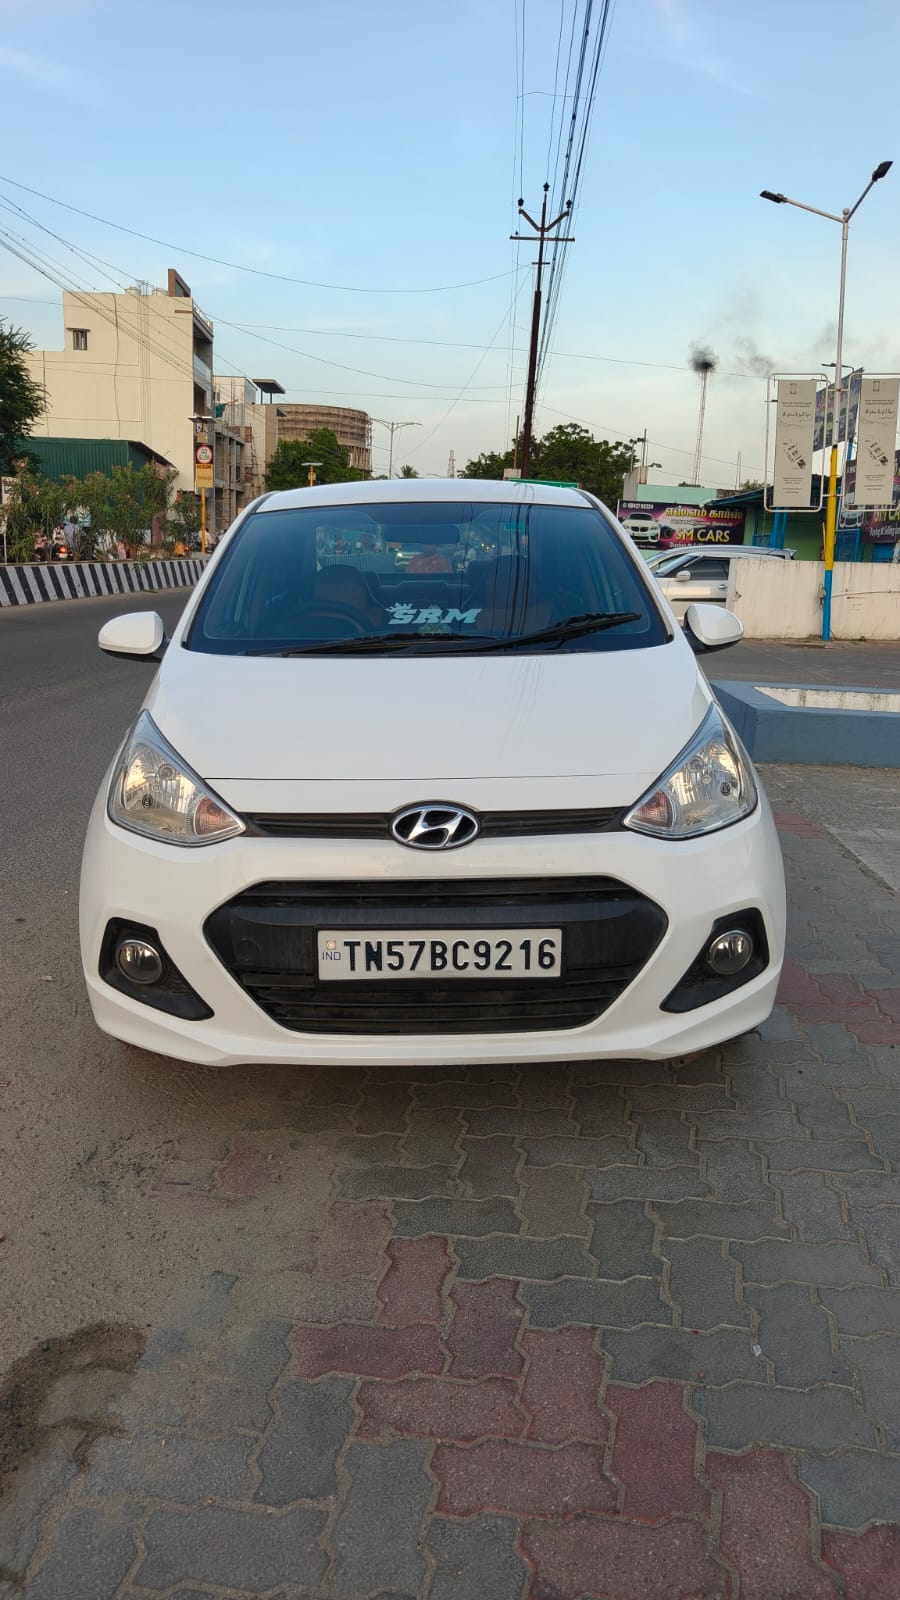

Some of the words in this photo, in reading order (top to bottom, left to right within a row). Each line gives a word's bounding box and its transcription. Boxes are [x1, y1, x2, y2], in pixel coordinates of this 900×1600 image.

[675, 528, 694, 541] SM
[697, 529, 730, 543] CARS
[387, 605, 482, 625] SRM
[322, 951, 342, 960] IND
[343, 939, 556, 971] TN57BC9216
